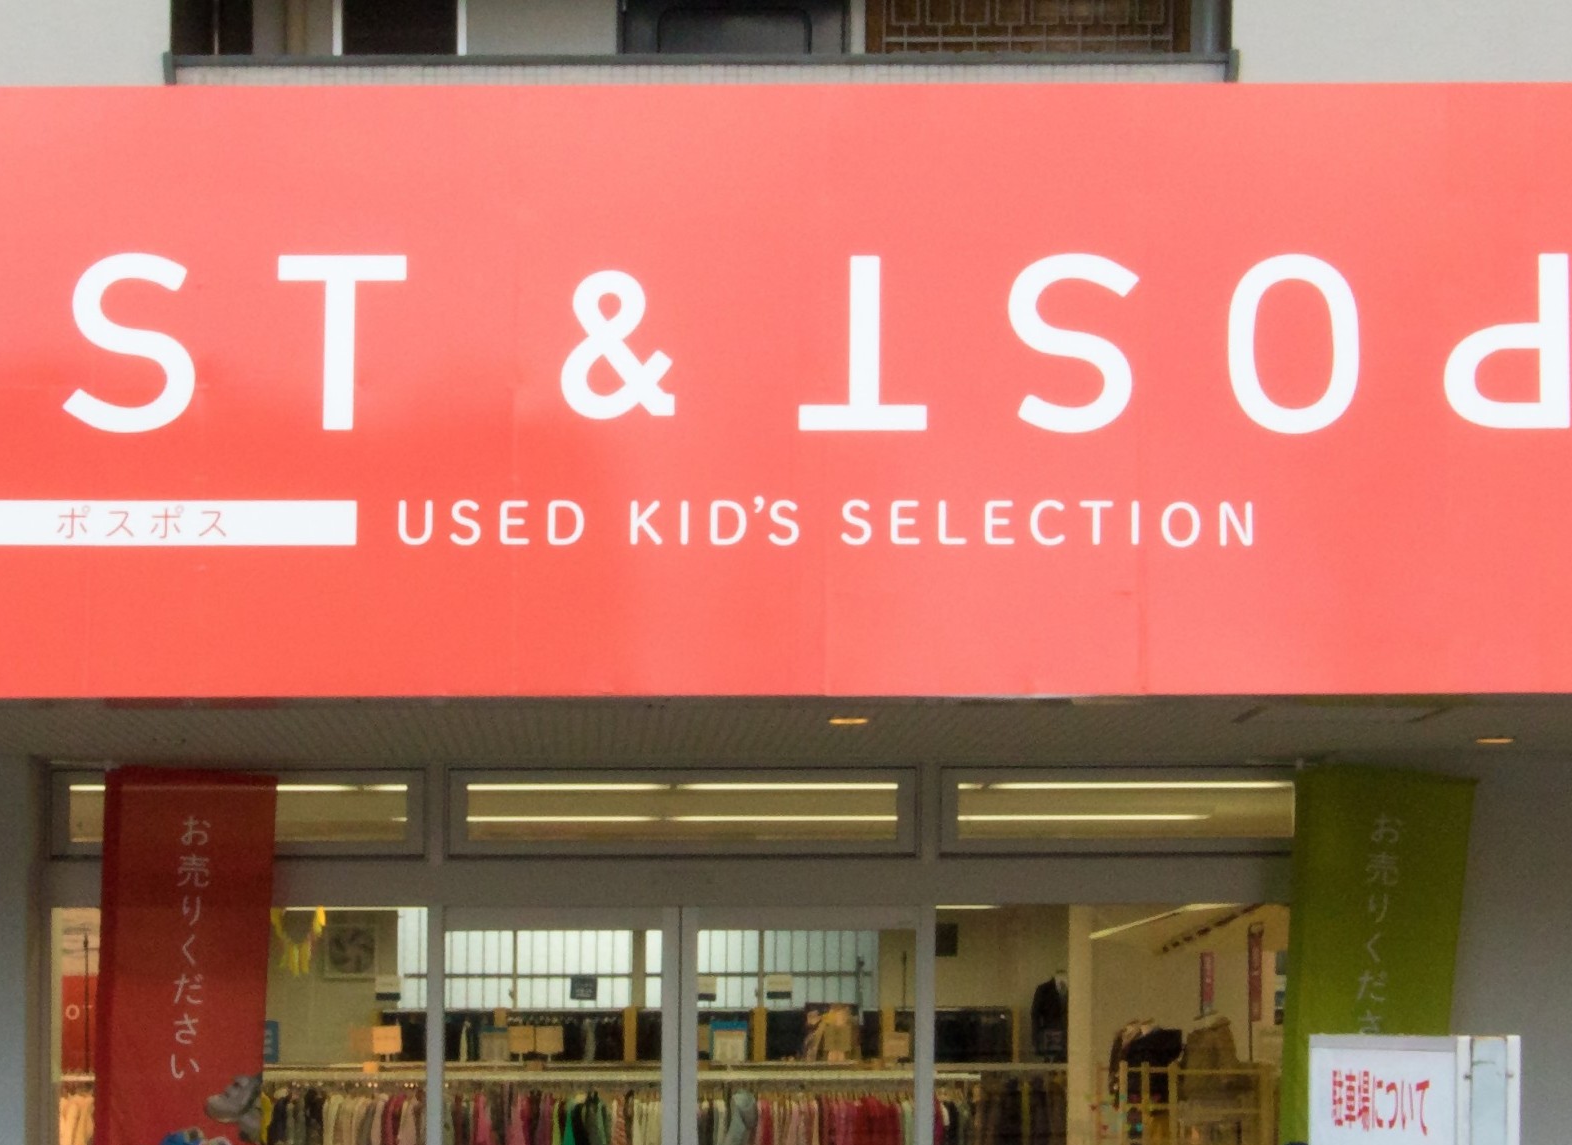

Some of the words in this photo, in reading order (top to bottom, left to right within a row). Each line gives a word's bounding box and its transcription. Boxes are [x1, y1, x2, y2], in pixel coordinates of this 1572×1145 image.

[560, 270, 676, 420] &
[57, 505, 226, 539] ポスポス
[399, 500, 586, 547] USED
[630, 496, 801, 547] KID'S
[841, 500, 1255, 549] SELECTION
[170, 815, 211, 1080] お売りください
[1332, 1070, 1431, 1136] 駐車場について
